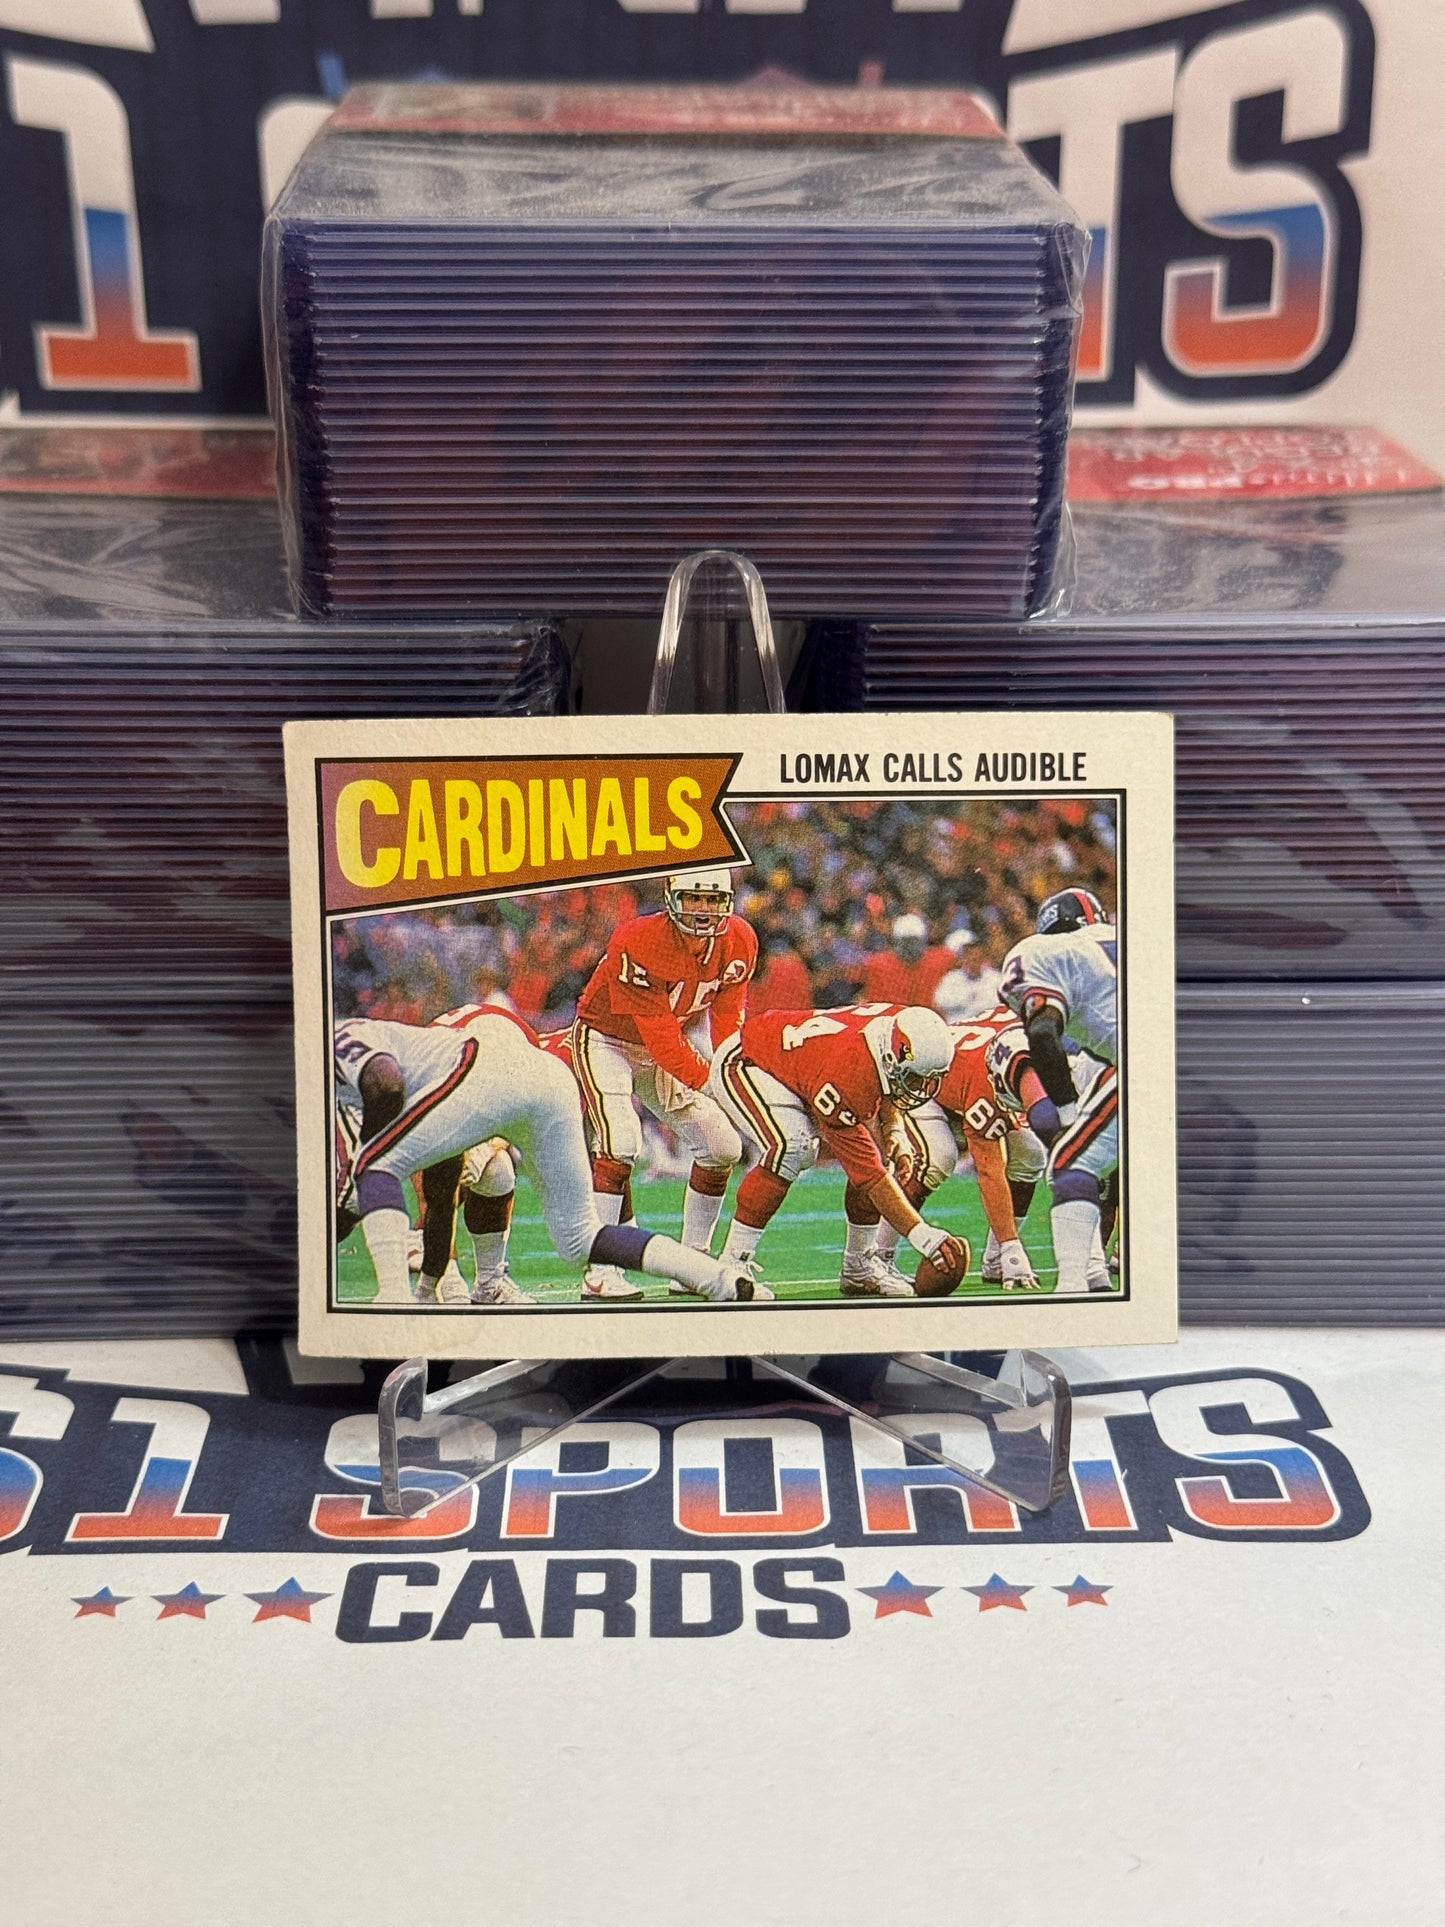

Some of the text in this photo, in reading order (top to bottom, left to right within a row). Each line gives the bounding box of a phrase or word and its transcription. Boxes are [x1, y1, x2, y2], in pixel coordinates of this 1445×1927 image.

[780, 752, 1087, 783] LOMAX CALLS AUDIBLE
[335, 776, 703, 888] CARDINALS
[308, 1378, 1342, 1540] SPORTS
[335, 1557, 851, 1644] CARDS
